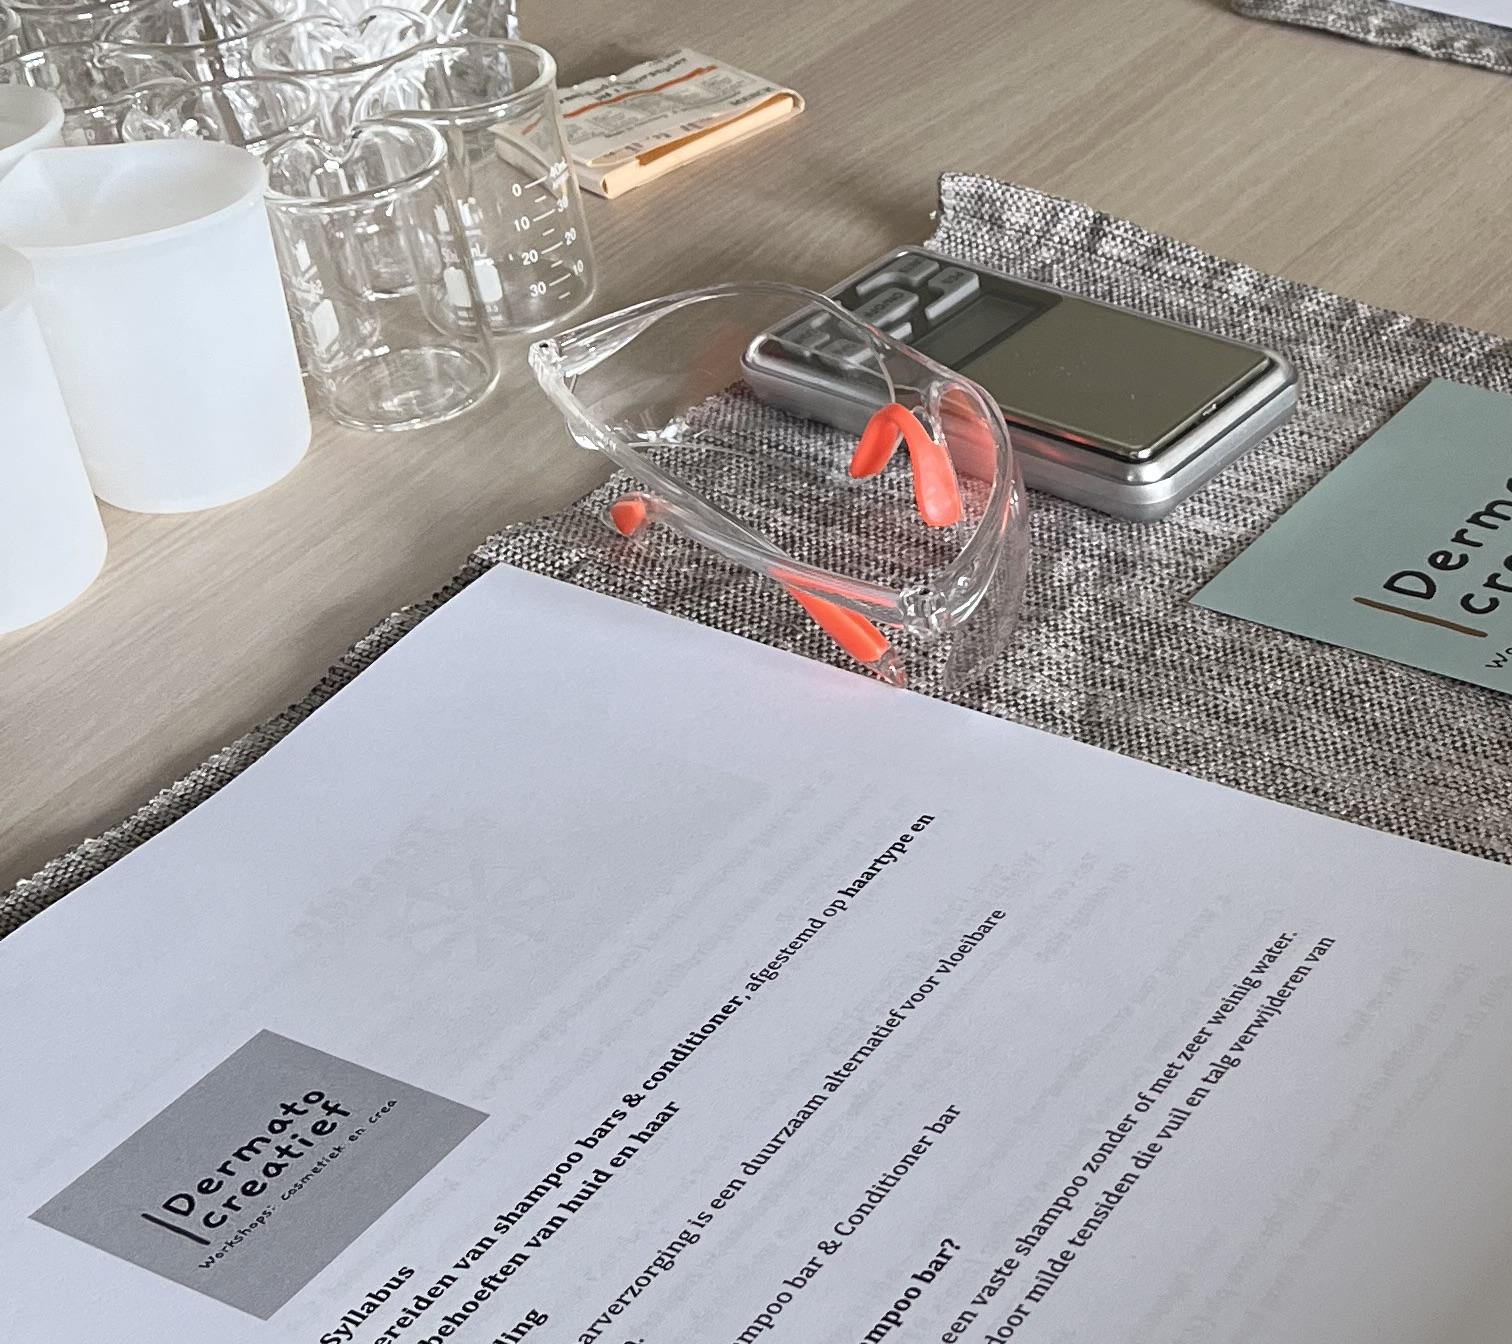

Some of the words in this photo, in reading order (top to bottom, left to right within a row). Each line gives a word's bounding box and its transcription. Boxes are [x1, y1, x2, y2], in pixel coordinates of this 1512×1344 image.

[514, 216, 530, 232] 10
[521, 249, 539, 266] 20
[529, 281, 547, 298] 30
[452, 1236, 498, 1269] van
[493, 1151, 584, 1234] shampoo
[574, 1108, 628, 1149] bars
[621, 1093, 647, 1108] &
[642, 995, 752, 1090] conditioner,
[744, 917, 827, 991] afgestemd
[822, 899, 848, 917] op
[836, 833, 914, 898] haartype
[910, 814, 936, 832] en
[686, 1210, 714, 1228] is
[710, 1178, 747, 1209] een
[740, 1094, 829, 1175] duurzaam
[822, 1008, 907, 1092] alternatief
[899, 975, 940, 1009] voor
[934, 910, 1006, 973] vloeibare
[161, 1090, 325, 1217] Dermato
[197, 1204, 275, 1268] Workshops:
[280, 1145, 345, 1200] cosmetiek
[348, 1128, 366, 1141] en
[368, 1100, 397, 1123] crea
[202, 1099, 350, 1228] creatief
[523, 1215, 568, 1247] van
[556, 1168, 614, 1213] huid
[609, 1145, 639, 1167] en
[627, 1100, 680, 1144] haar
[941, 1310, 978, 1344] een
[970, 1257, 1020, 1305] vaste
[1014, 1175, 1088, 1256] shampoo
[1081, 1113, 1138, 1173] zonder
[1134, 1091, 1156, 1112] of
[1148, 1061, 1185, 1094] met
[1176, 1026, 1213, 1061] zeer
[1206, 975, 1262, 1024] weinig
[1249, 932, 1298, 973] water.
[1024, 1249, 1076, 1303] milde
[1067, 1172, 1140, 1247] tensiden
[1130, 1142, 1163, 1169] die
[1155, 1107, 1192, 1138] vuil
[1185, 1086, 1211, 1106] en
[1200, 1054, 1241, 1084] talg
[1228, 965, 1313, 1051] verwijderen
[1304, 937, 1336, 961] van
[782, 1255, 824, 1289] bar
[816, 1239, 843, 1255] &
[833, 1134, 934, 1236] Conditioner
[922, 1104, 961, 1134] bar
[910, 1237, 961, 1284] bar?
